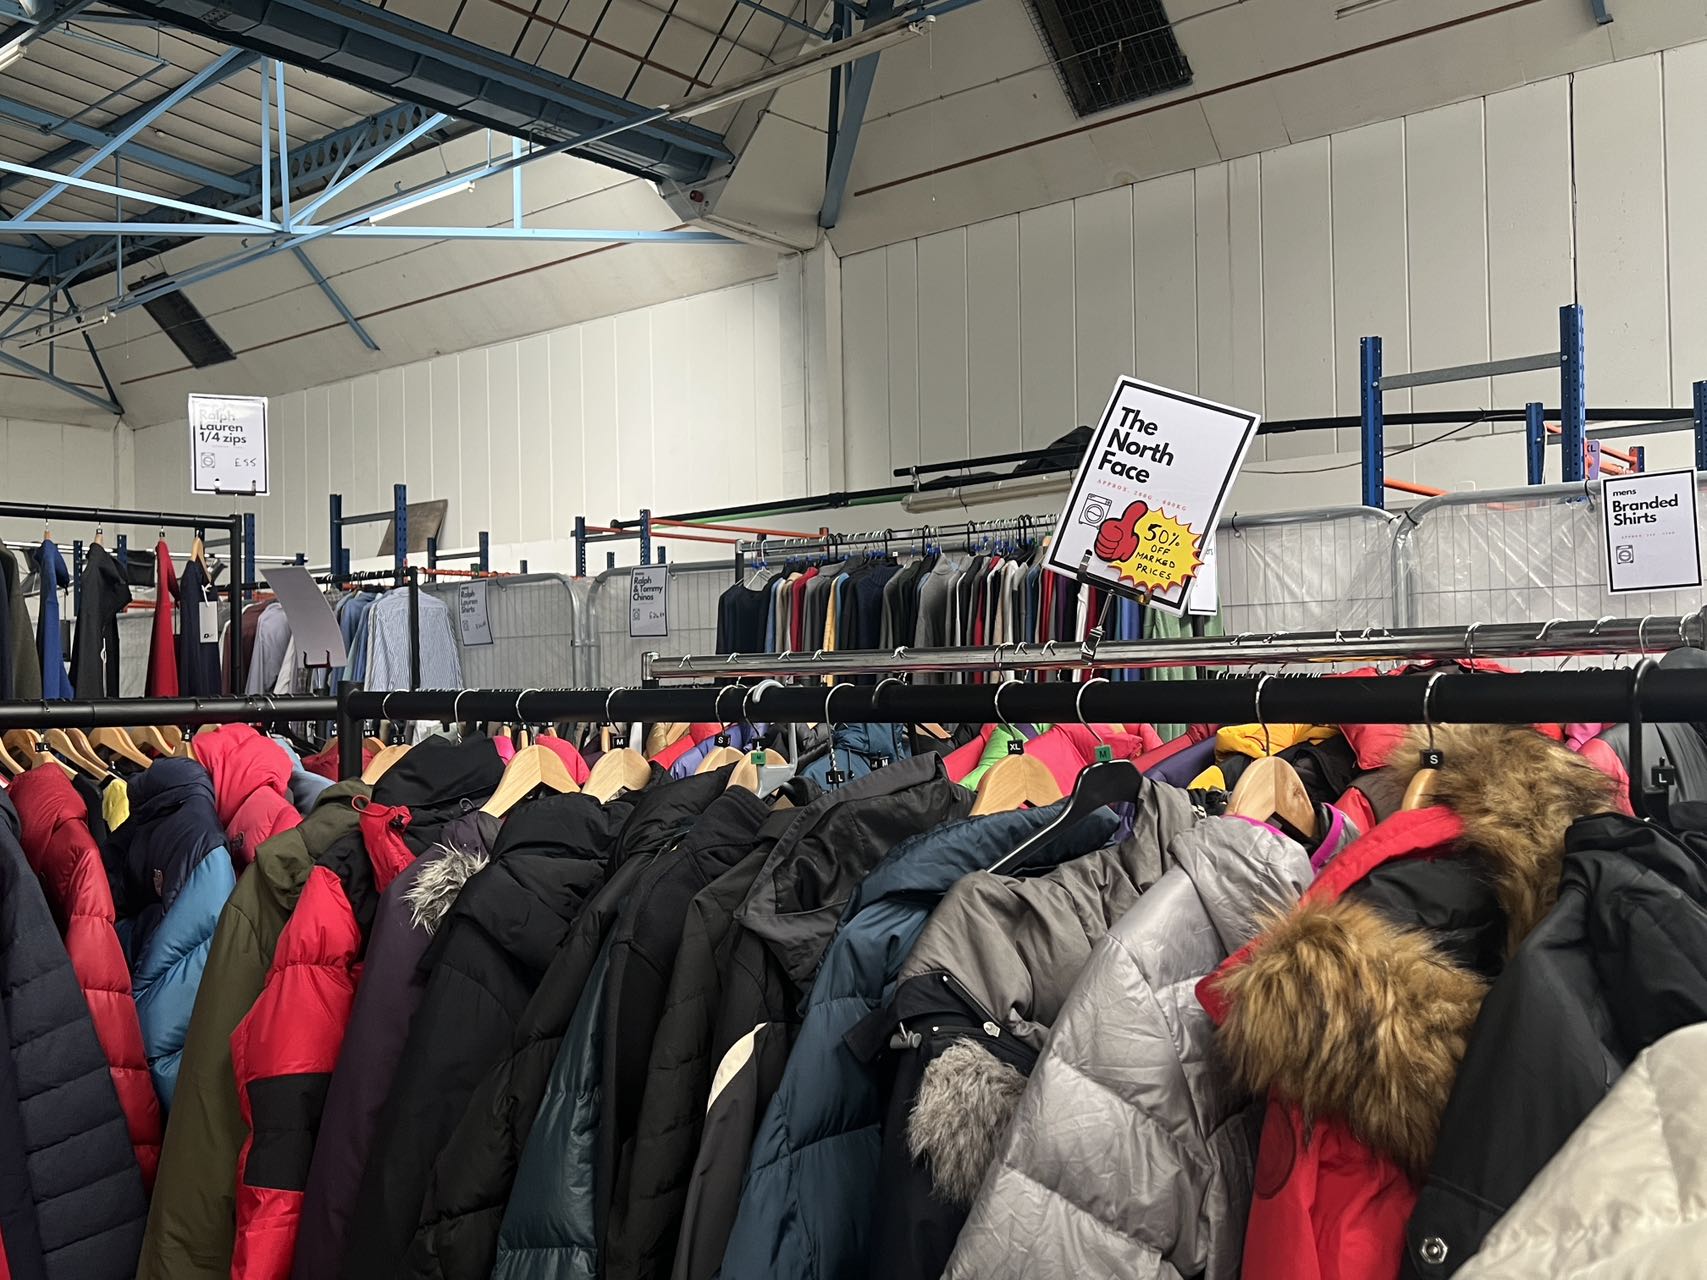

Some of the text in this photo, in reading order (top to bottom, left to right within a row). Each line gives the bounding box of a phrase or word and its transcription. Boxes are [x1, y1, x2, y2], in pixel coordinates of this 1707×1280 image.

[1121, 407, 1158, 435] The
[200, 423, 243, 432] Lauren
[200, 432, 247, 446] 1/4 zips
[1107, 429, 1174, 466] North
[1098, 451, 1150, 483] Face
[1612, 493, 1678, 513] Branded
[1613, 512, 1657, 526] Shirts
[1144, 524, 1180, 546] 50%
[1150, 545, 1170, 555] OFF
[1135, 552, 1175, 569] MARKED
[1136, 563, 1172, 580] PRICES
[640, 585, 663, 593] Tommy
[717, 736, 724, 744] S
[1009, 743, 1021, 751] XL
[881, 758, 889, 768] M
[1430, 754, 1439, 765] S
[838, 774, 843, 782] L
[1658, 773, 1667, 783] L
